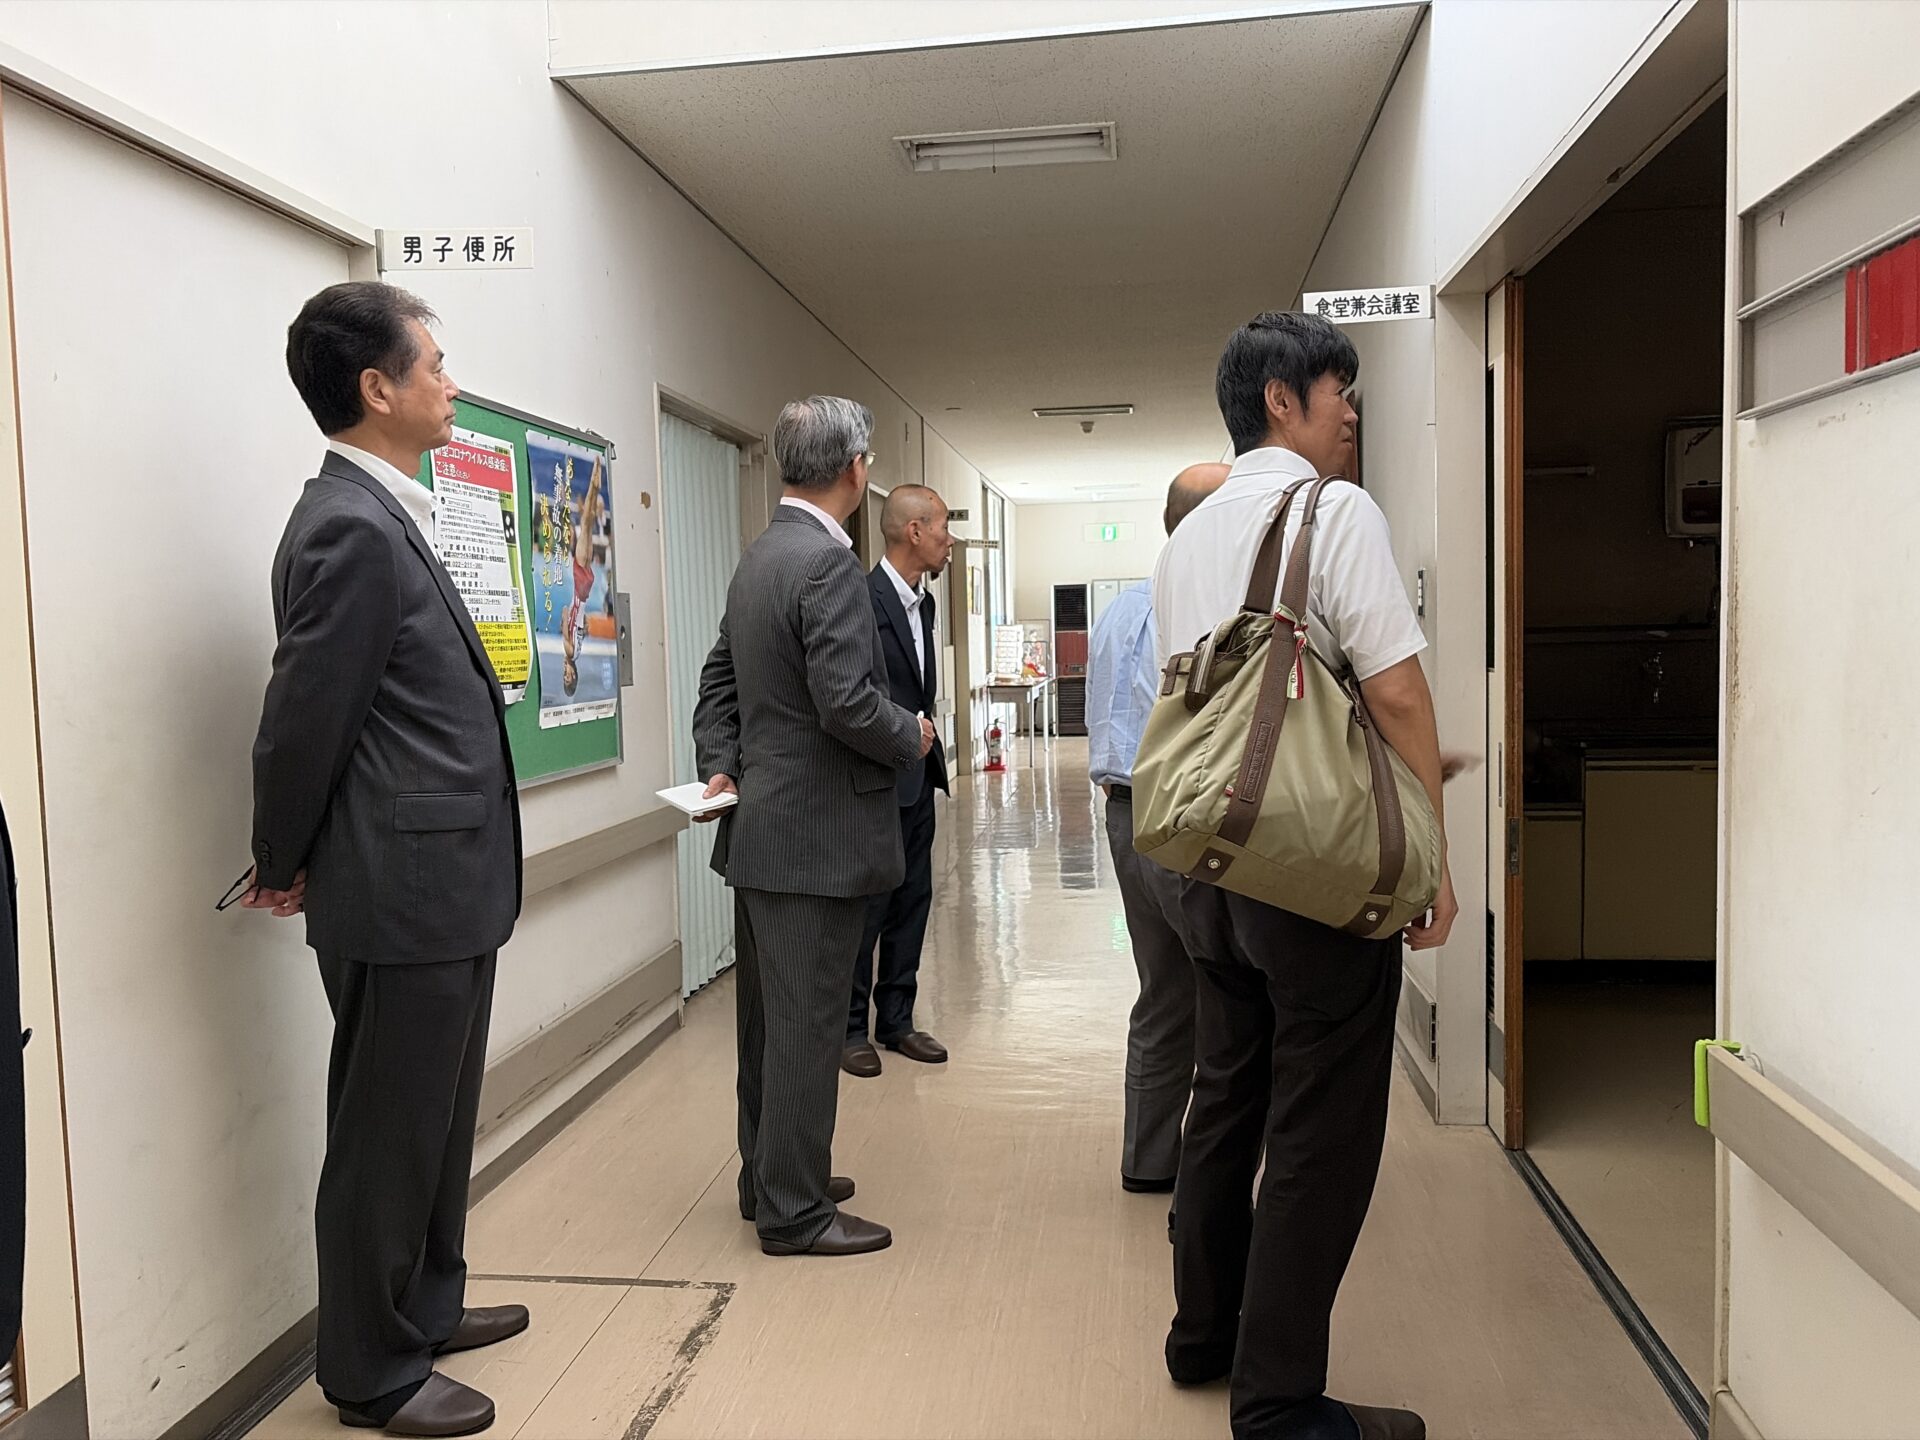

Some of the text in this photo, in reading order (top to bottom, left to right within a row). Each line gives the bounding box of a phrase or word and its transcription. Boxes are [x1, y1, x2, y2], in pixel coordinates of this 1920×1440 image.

[403, 235, 515, 263] 男子便所
[1315, 292, 1420, 318] 食堂兼会議室
[552, 462, 564, 586] 無事故の着地
[562, 457, 574, 568] あなたなら
